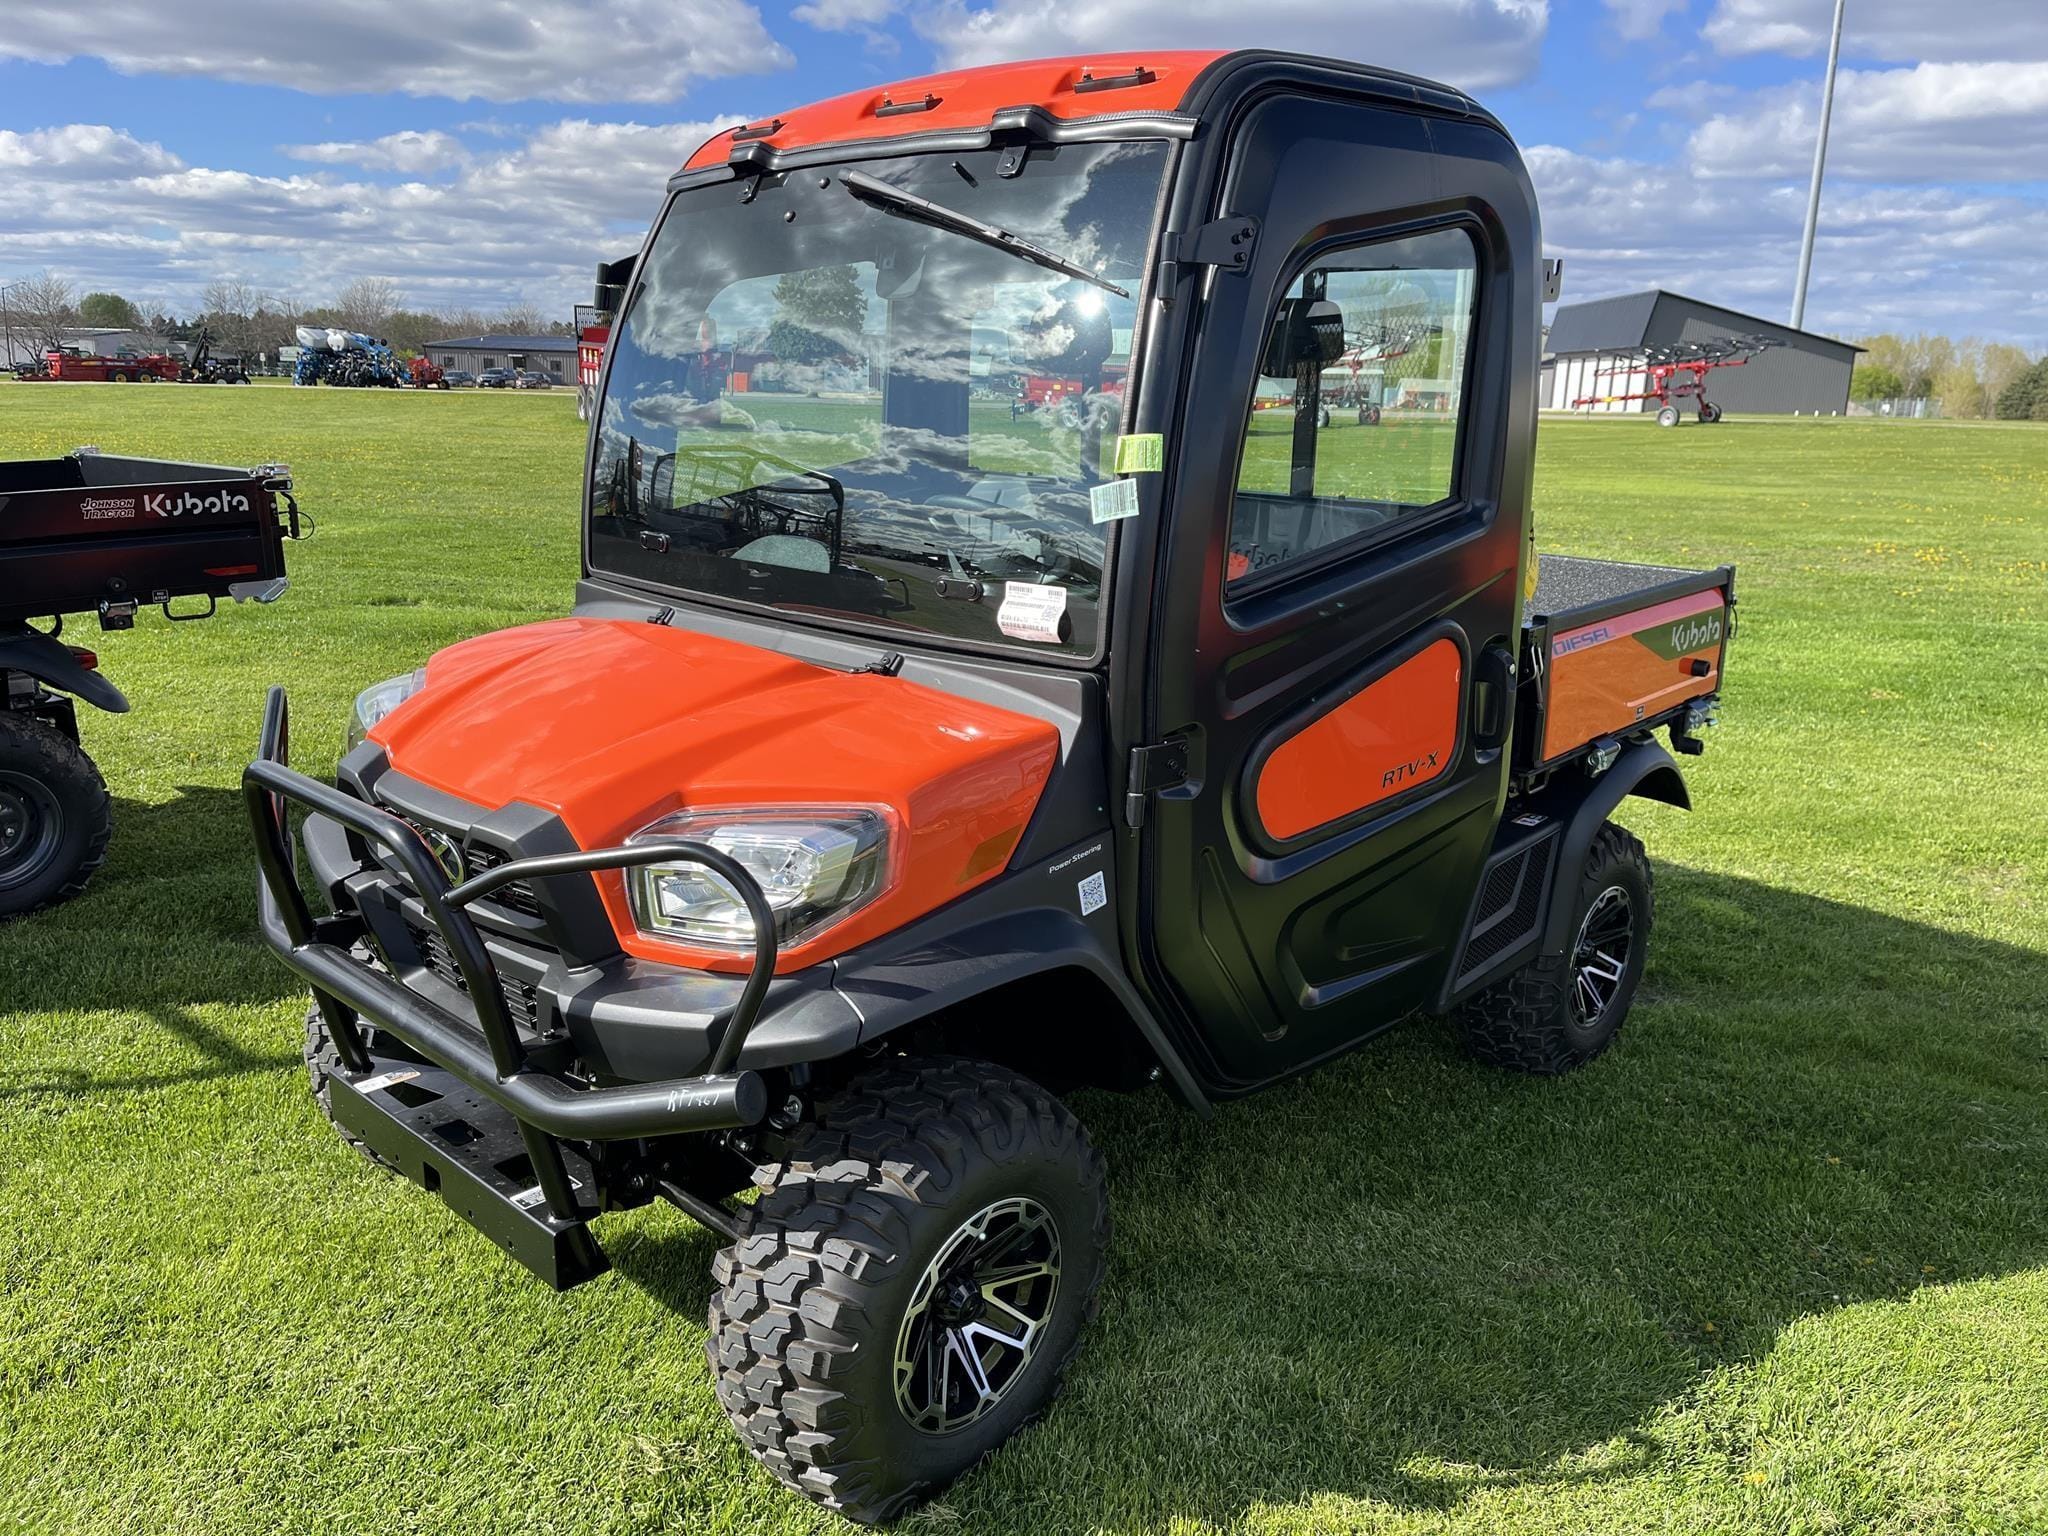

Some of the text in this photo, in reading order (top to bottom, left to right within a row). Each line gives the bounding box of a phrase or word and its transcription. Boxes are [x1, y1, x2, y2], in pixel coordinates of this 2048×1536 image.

[80, 498, 135, 509] JOHNSON
[82, 508, 135, 519] TRACTOR
[143, 490, 249, 517] Kubota
[1553, 627, 1617, 656] DIESEL
[1671, 615, 1721, 651] Kubota
[1382, 750, 1439, 789] RTV-X
[1049, 843, 1102, 874] Power Steering
